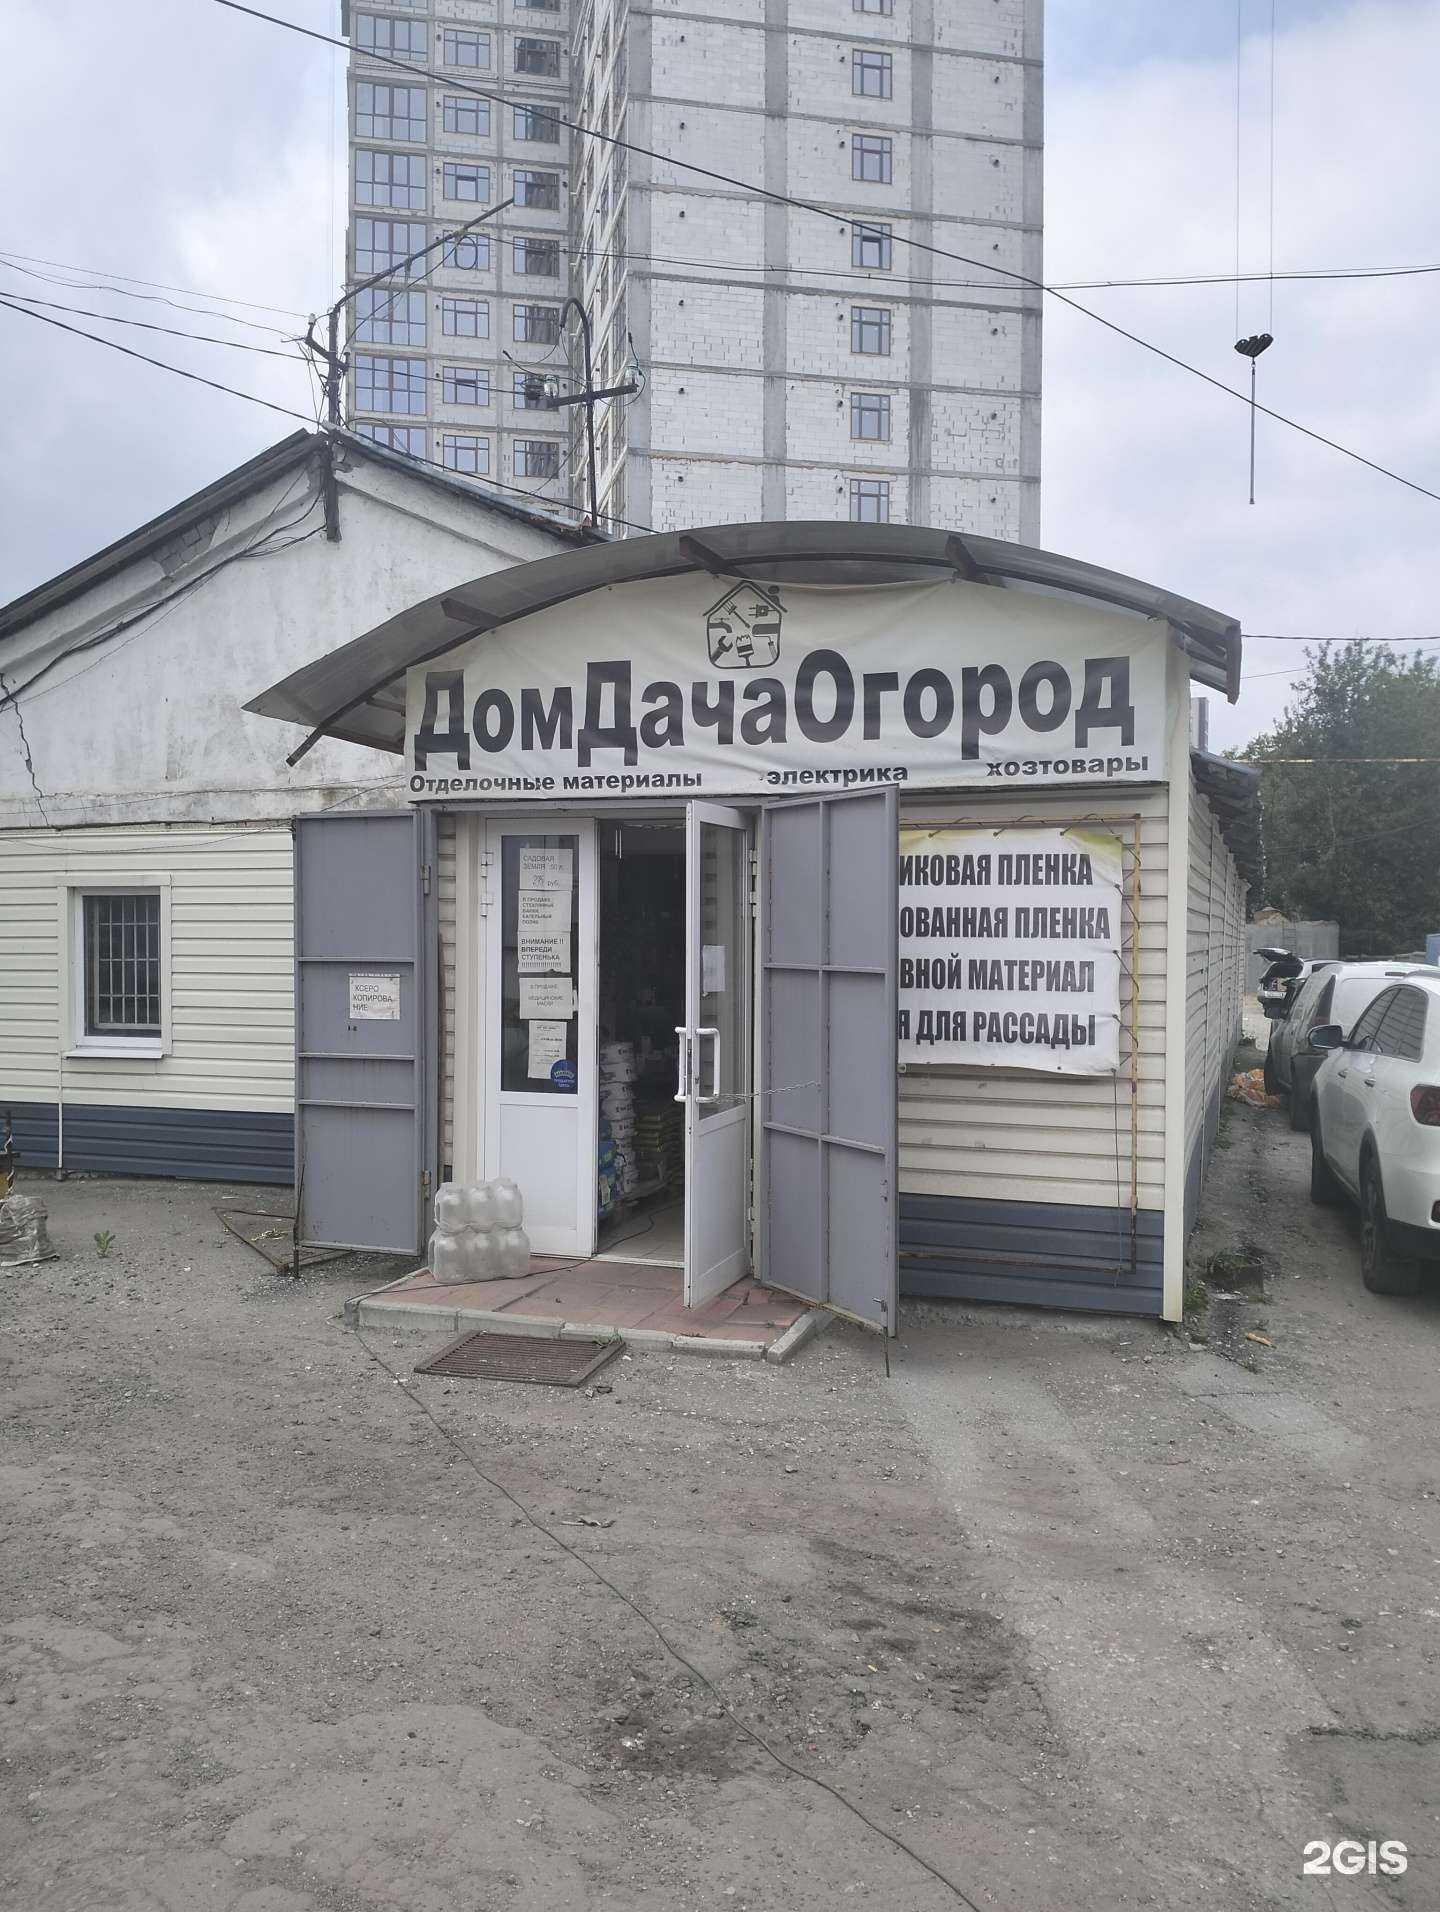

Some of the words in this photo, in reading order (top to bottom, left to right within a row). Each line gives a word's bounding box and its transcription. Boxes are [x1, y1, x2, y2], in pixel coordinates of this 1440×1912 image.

[414, 648, 1135, 772] ДомДачаОгород
[410, 774, 555, 793] Отделочные
[563, 772, 702, 792] материалы
[766, 766, 908, 787] электрика
[986, 756, 1148, 777] хозтовары
[998, 853, 1093, 886] ПЛЕНКА
[900, 906, 1008, 938] ОВАННАЯ
[1015, 907, 1110, 939] ПЛЕНКА
[900, 952, 962, 990] ВНОЙ
[968, 958, 1095, 993] МАТЕРИАЛ
[916, 1009, 967, 1046] ДЛЯ
[973, 1010, 1096, 1050] РАССАДЫ
